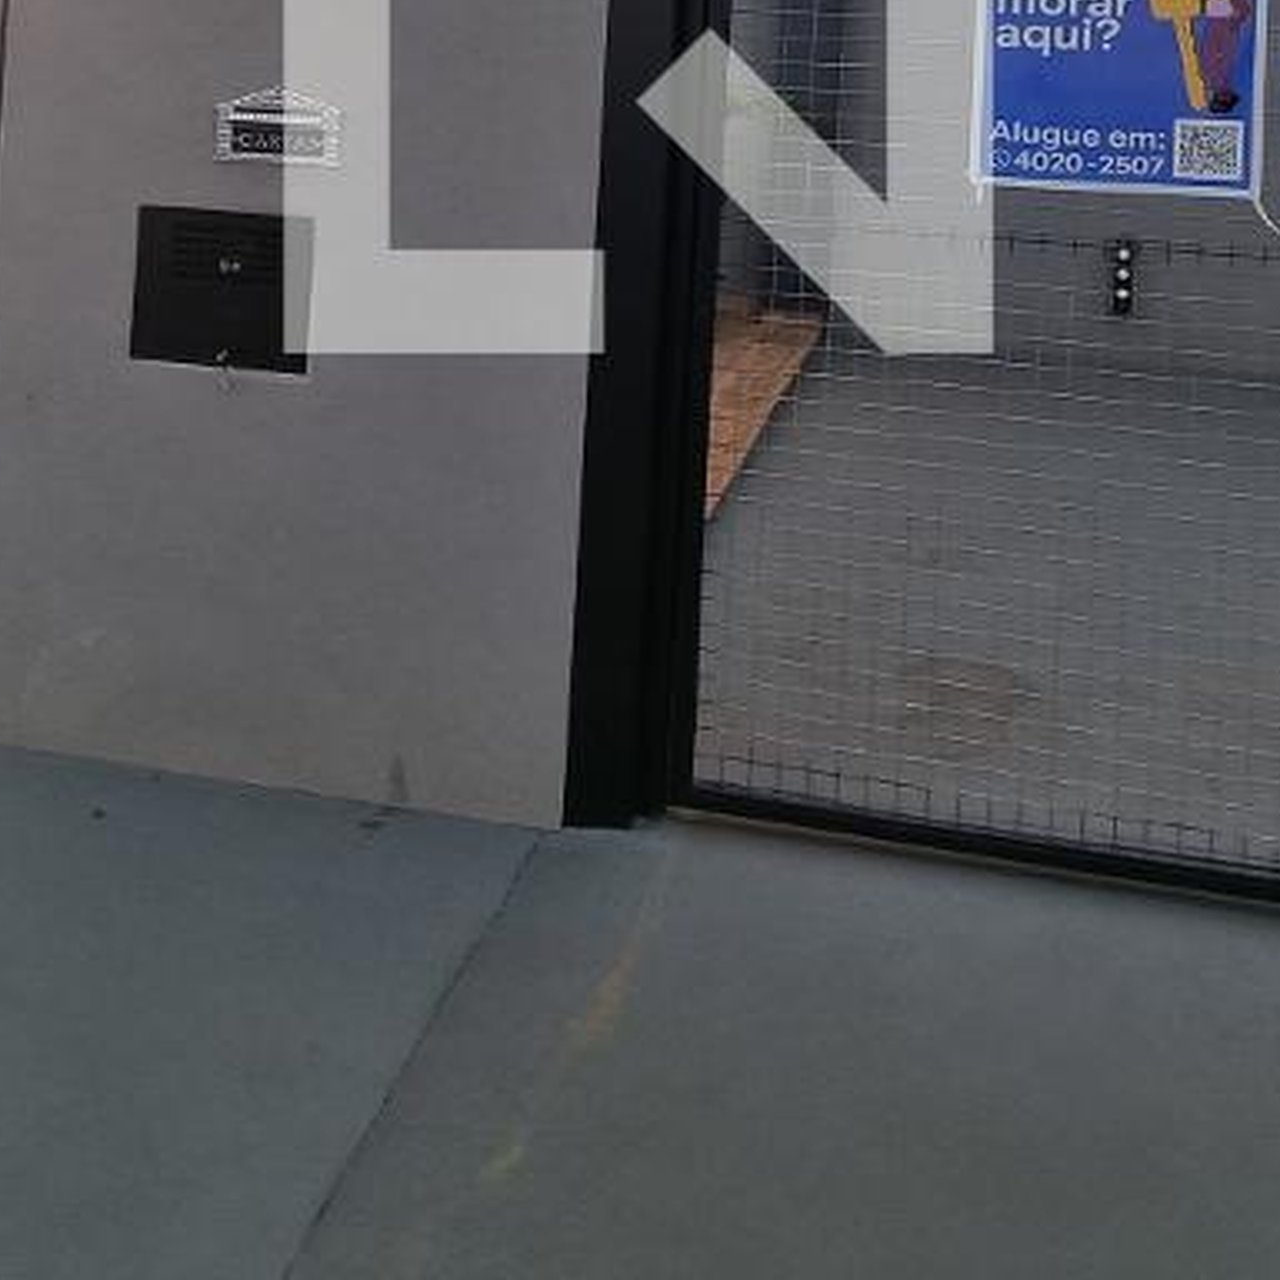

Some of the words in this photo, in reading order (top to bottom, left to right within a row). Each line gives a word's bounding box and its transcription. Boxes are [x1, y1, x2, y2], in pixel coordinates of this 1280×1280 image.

[995, 18, 1121, 57] aqui?
[988, 119, 1102, 150] Alugue
[1108, 127, 1167, 151] em:
[1012, 151, 1165, 176] 4020-2507
